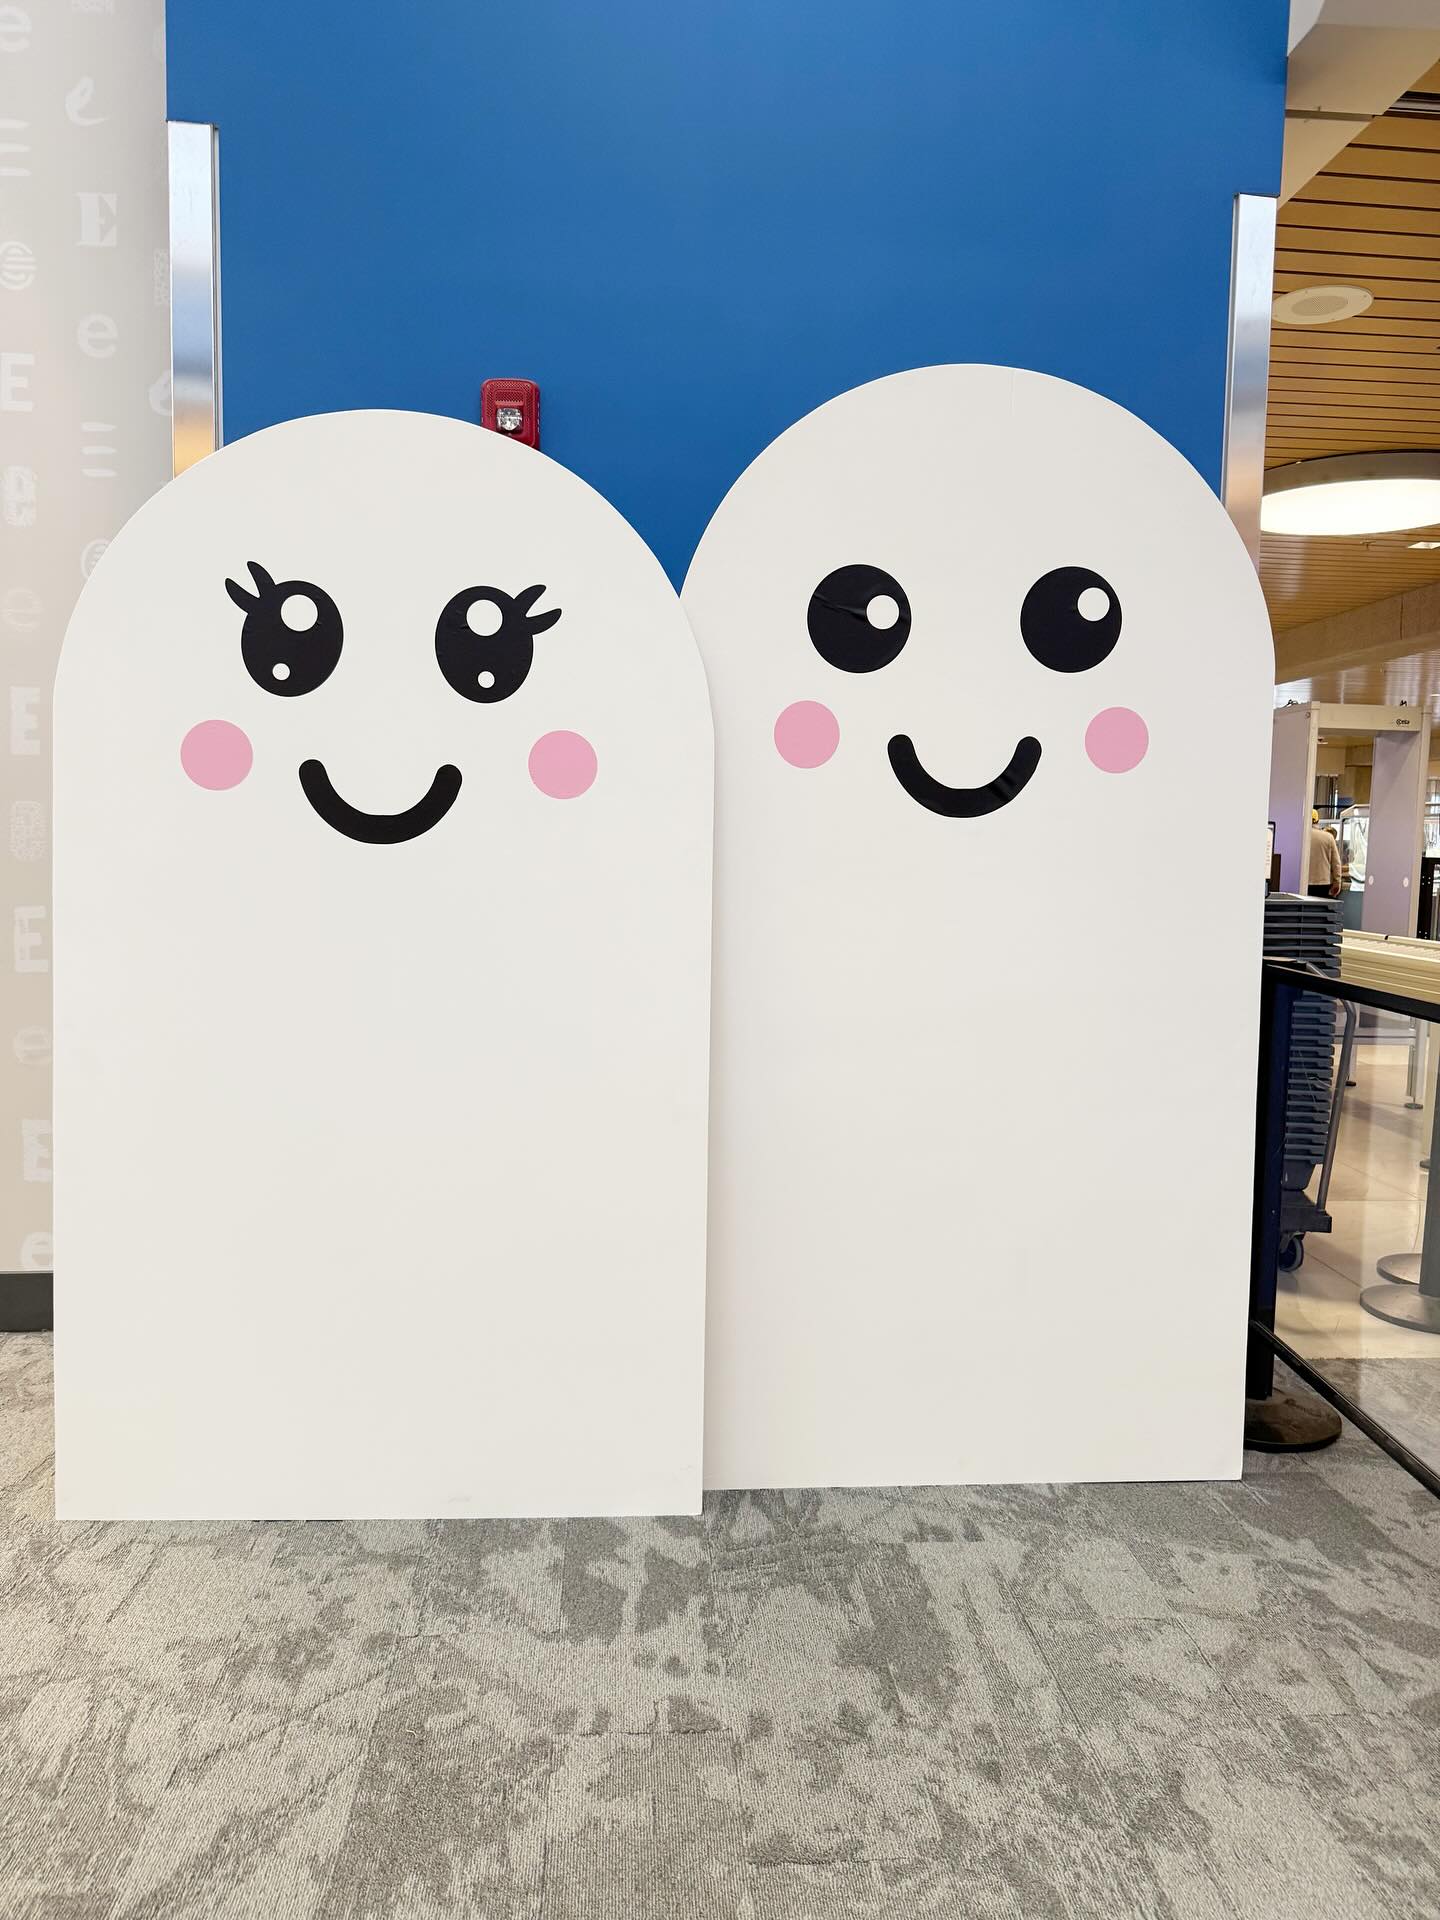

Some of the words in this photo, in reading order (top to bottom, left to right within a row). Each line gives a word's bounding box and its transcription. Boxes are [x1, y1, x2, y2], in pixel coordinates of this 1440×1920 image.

[73, 191, 118, 248] E
[77, 313, 118, 359] e
[0, 353, 35, 412] E
[2, 587, 42, 631] e
[9, 685, 41, 755] E
[14, 905, 49, 973] E
[13, 1025, 51, 1066] e
[22, 1118, 53, 1183] E
